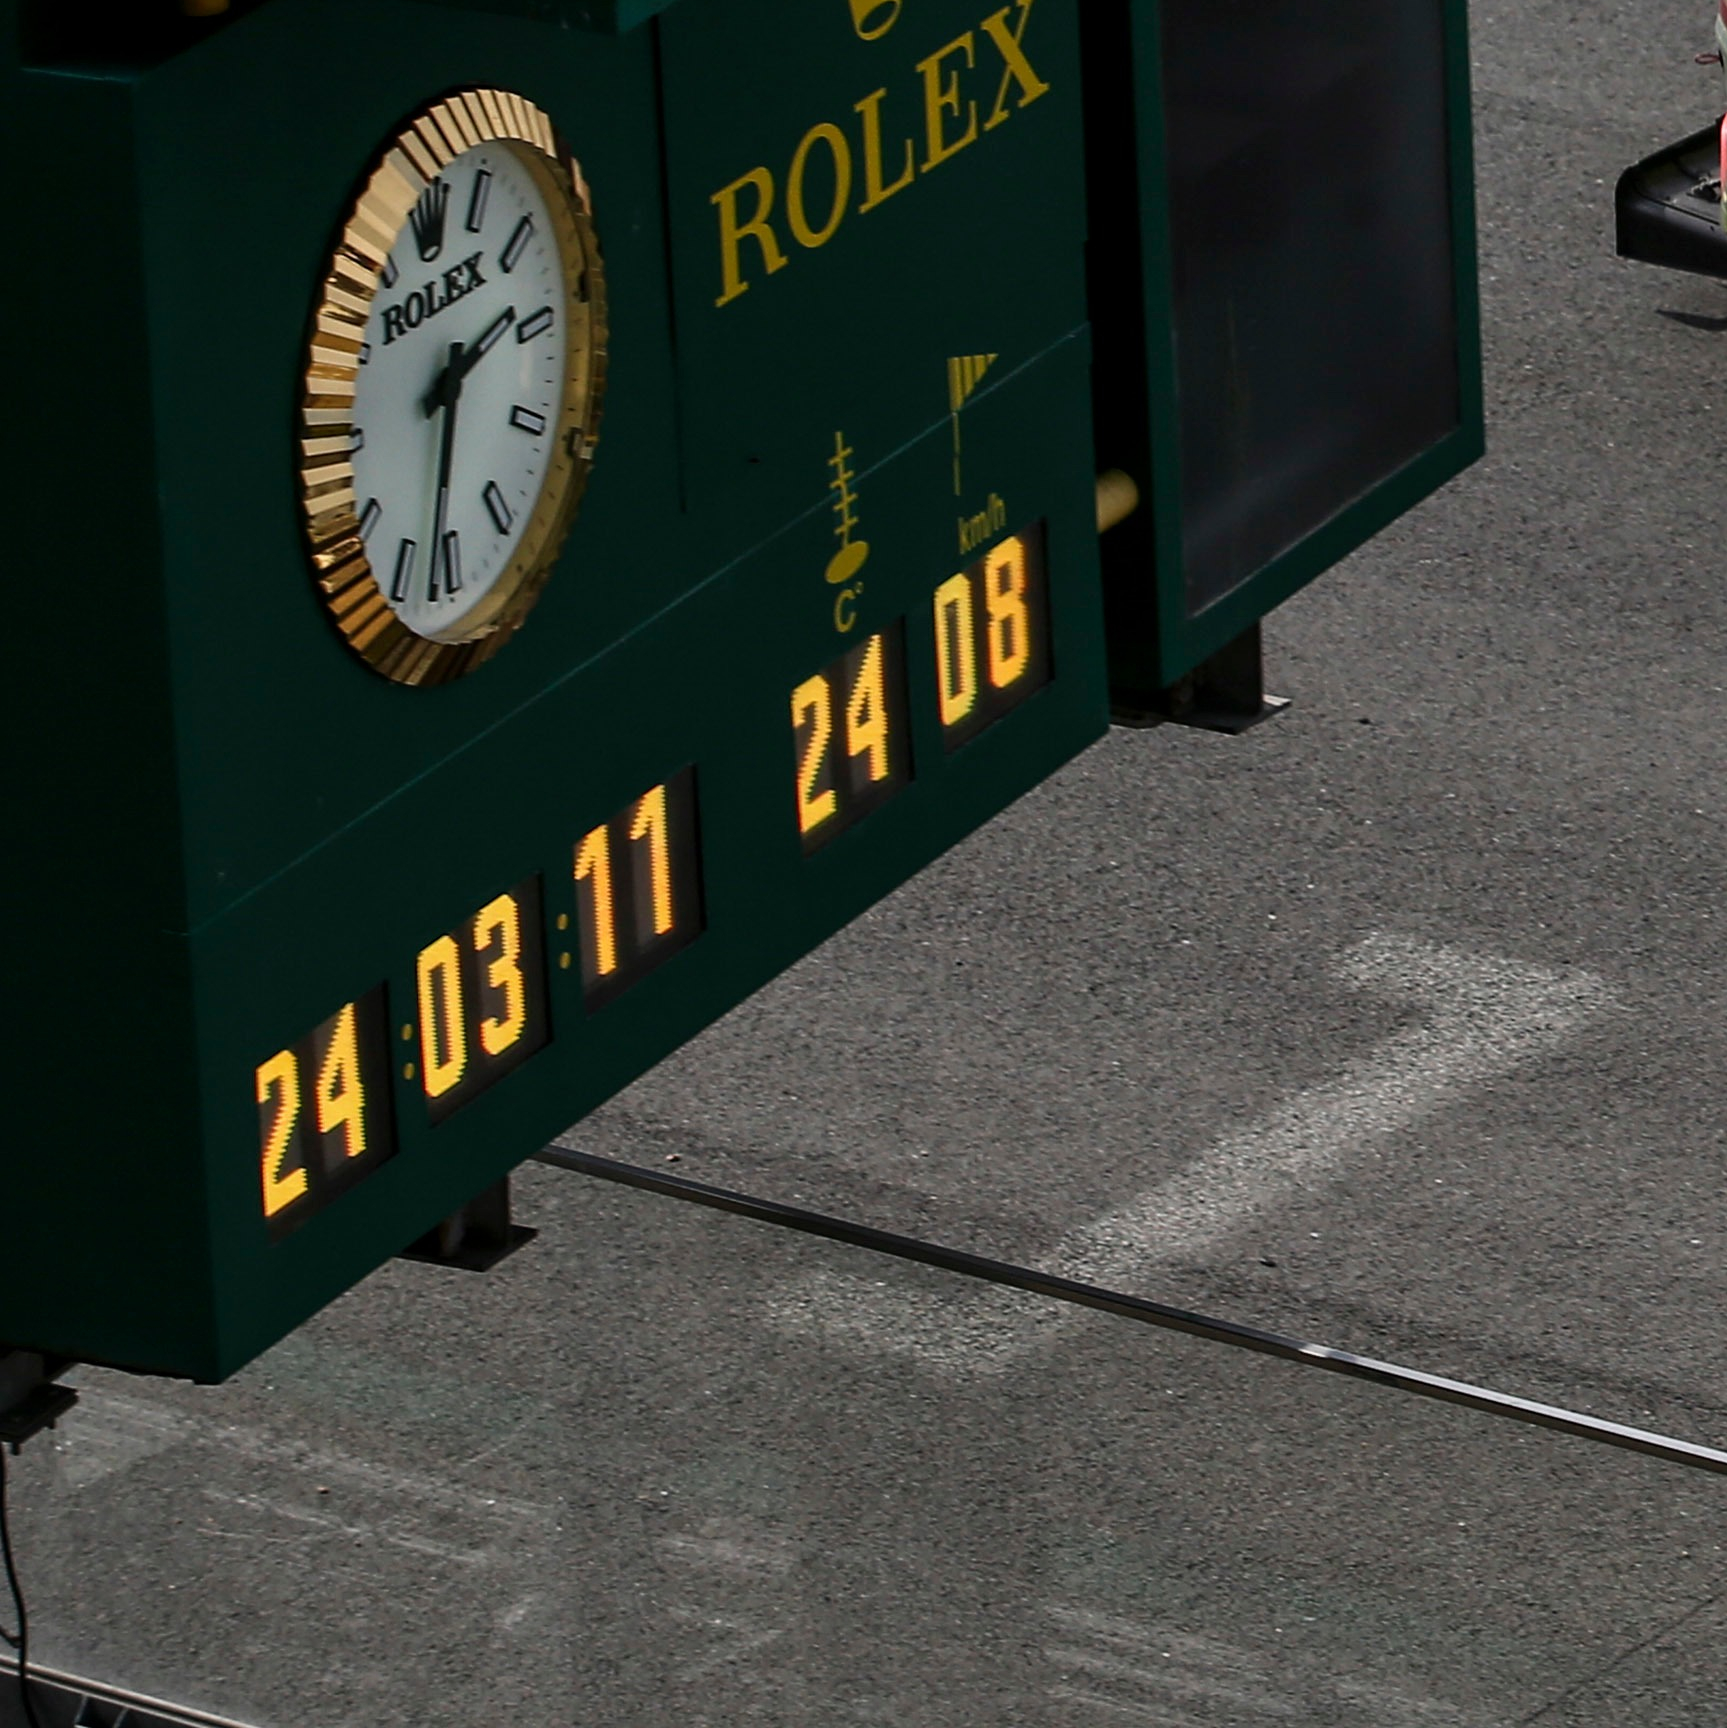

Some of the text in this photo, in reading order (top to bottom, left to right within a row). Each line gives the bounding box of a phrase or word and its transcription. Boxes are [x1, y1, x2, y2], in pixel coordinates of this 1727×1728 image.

[381, 252, 488, 346] ROLEX
[955, 492, 1007, 555] km/h
[933, 535, 1030, 727] 08
[791, 634, 890, 834] 24
